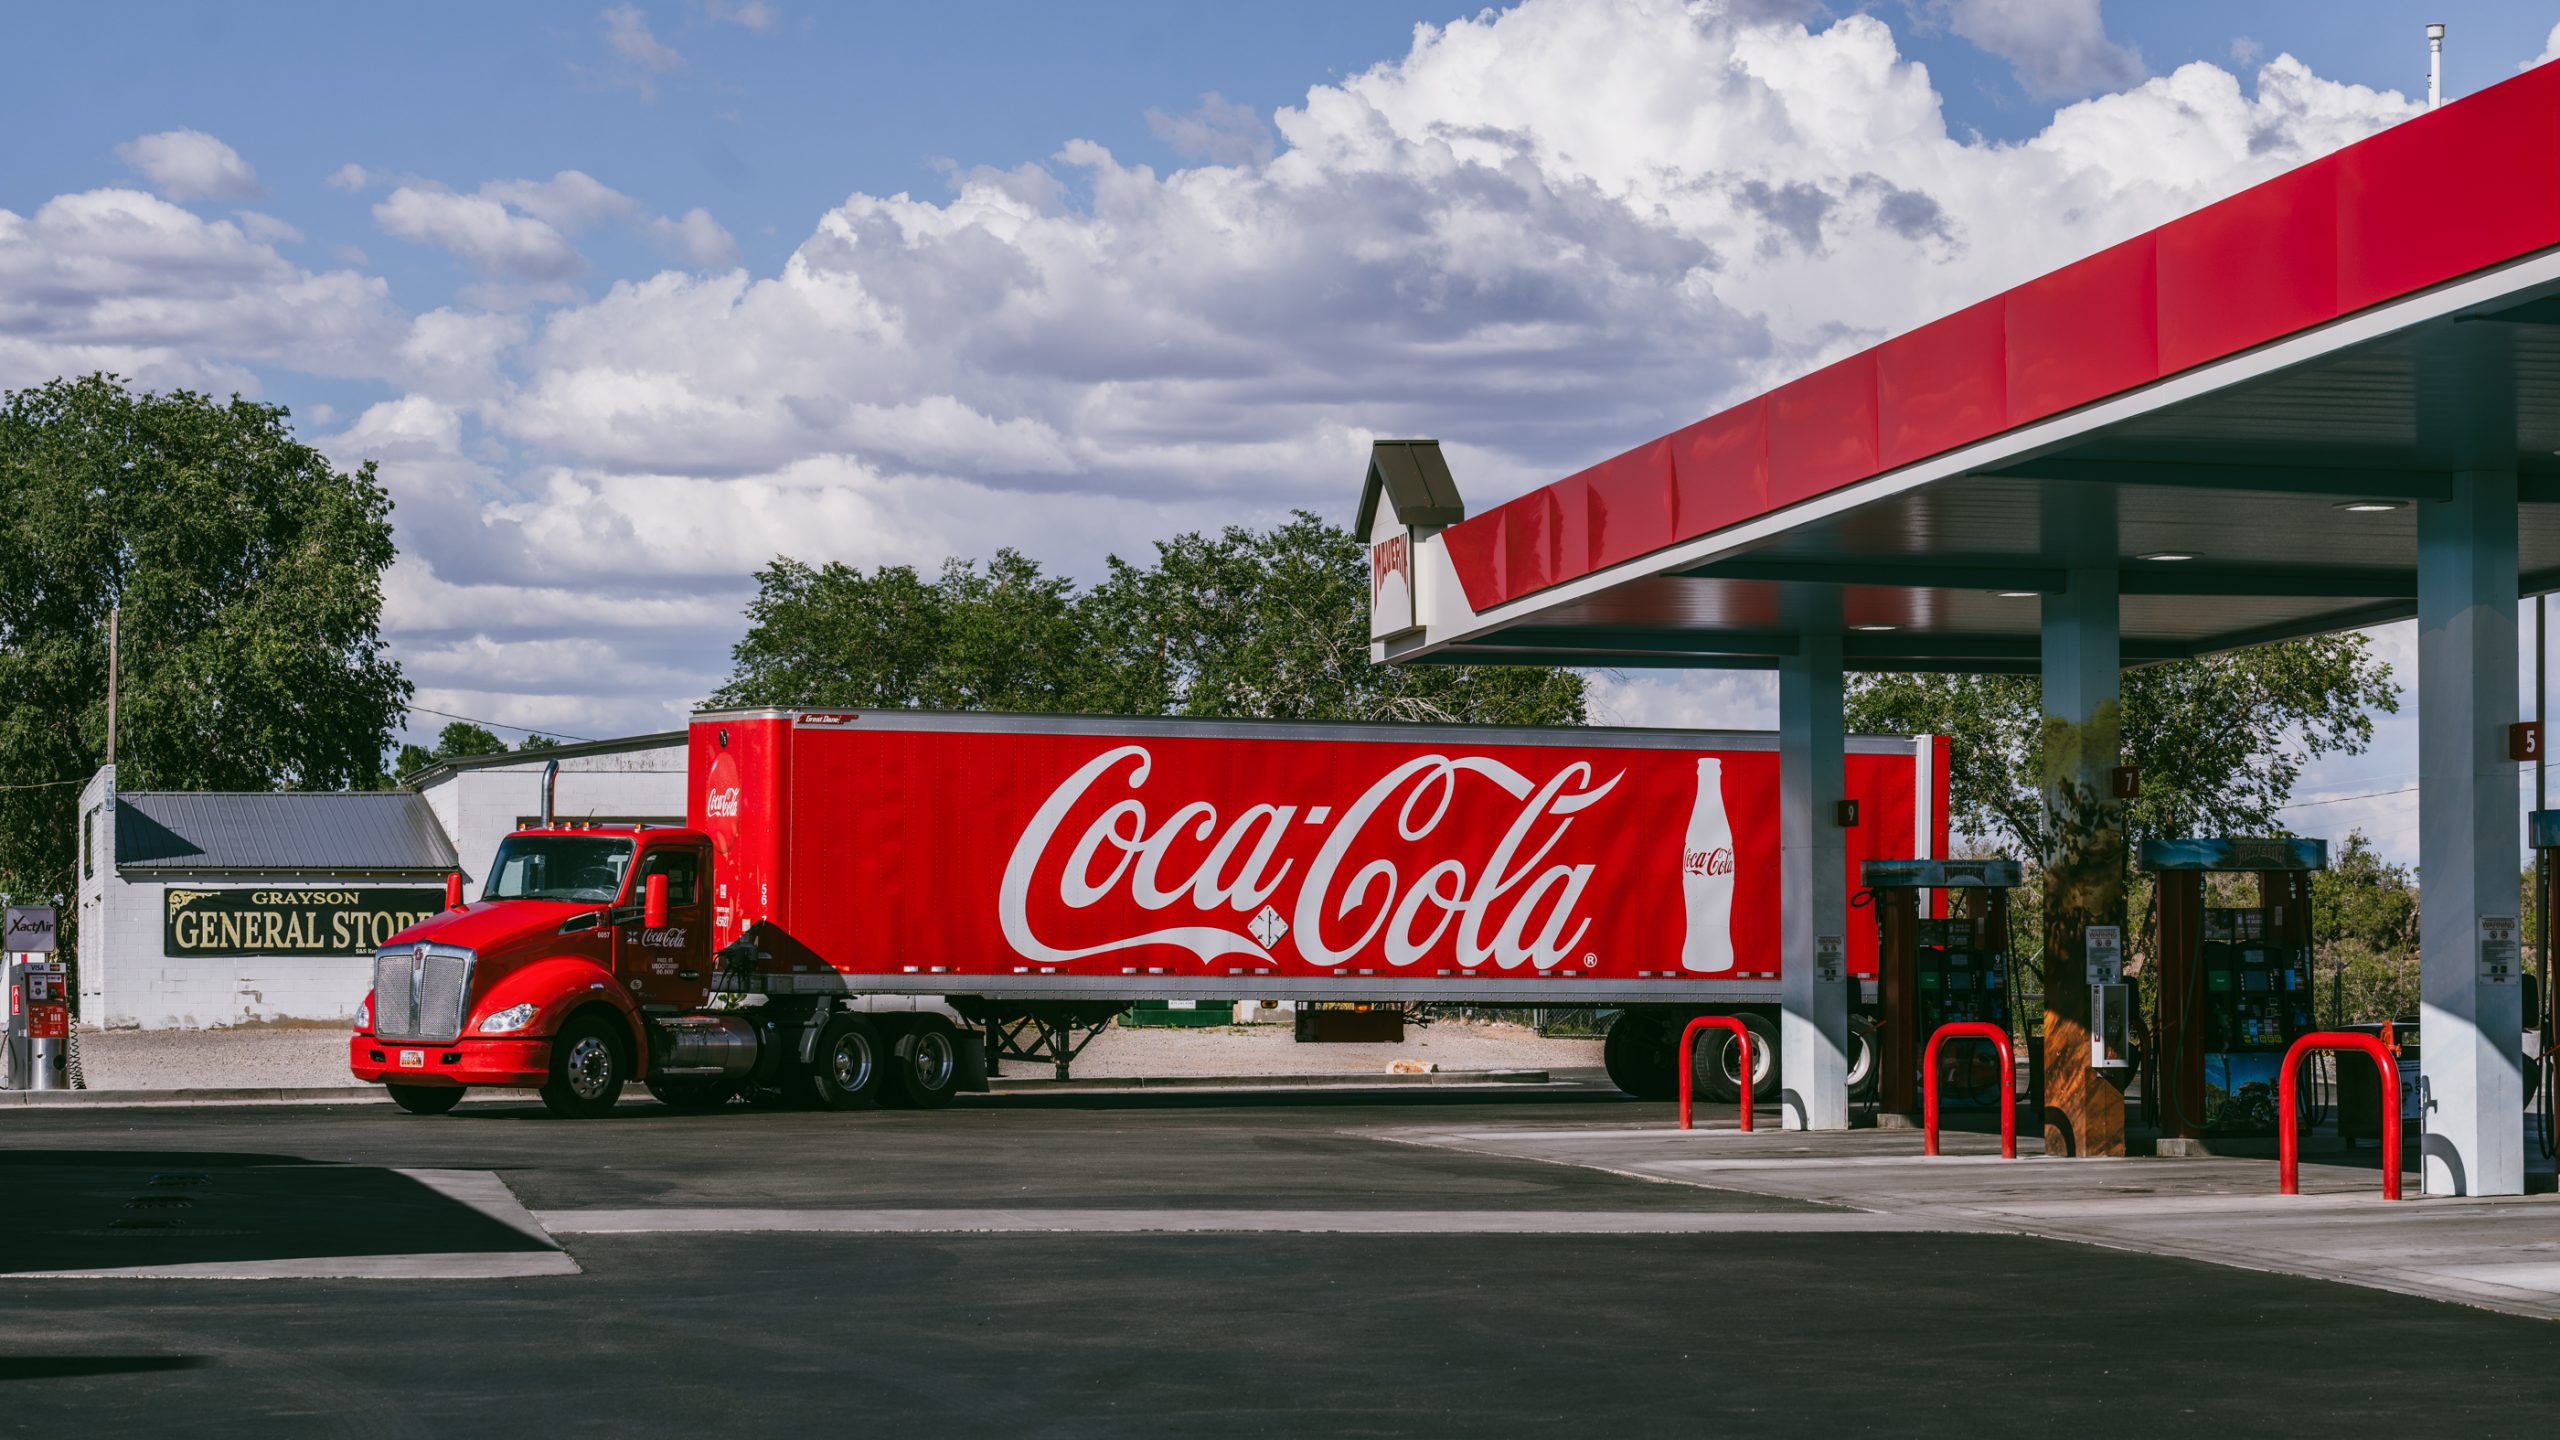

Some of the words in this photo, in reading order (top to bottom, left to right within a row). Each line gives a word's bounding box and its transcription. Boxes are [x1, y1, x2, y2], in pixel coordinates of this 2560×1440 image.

[1373, 532, 1409, 614] MAVERIK
[805, 715, 822, 723] Great
[823, 715, 840, 723] Dane
[2526, 729, 2536, 753] 5
[2125, 772, 2133, 792] 7
[708, 787, 740, 817] Coca-Cola
[1848, 805, 1854, 822] 9
[999, 745, 1626, 969] Coca-Cola
[1684, 847, 1732, 877] Coca-Cola
[251, 891, 360, 905] GRAYSON
[8, 915, 53, 935] XactAir
[175, 911, 325, 948] GENERAL
[332, 911, 434, 948] STO
[2482, 920, 2515, 929] WARNING
[641, 927, 688, 947] Coca-Cola
